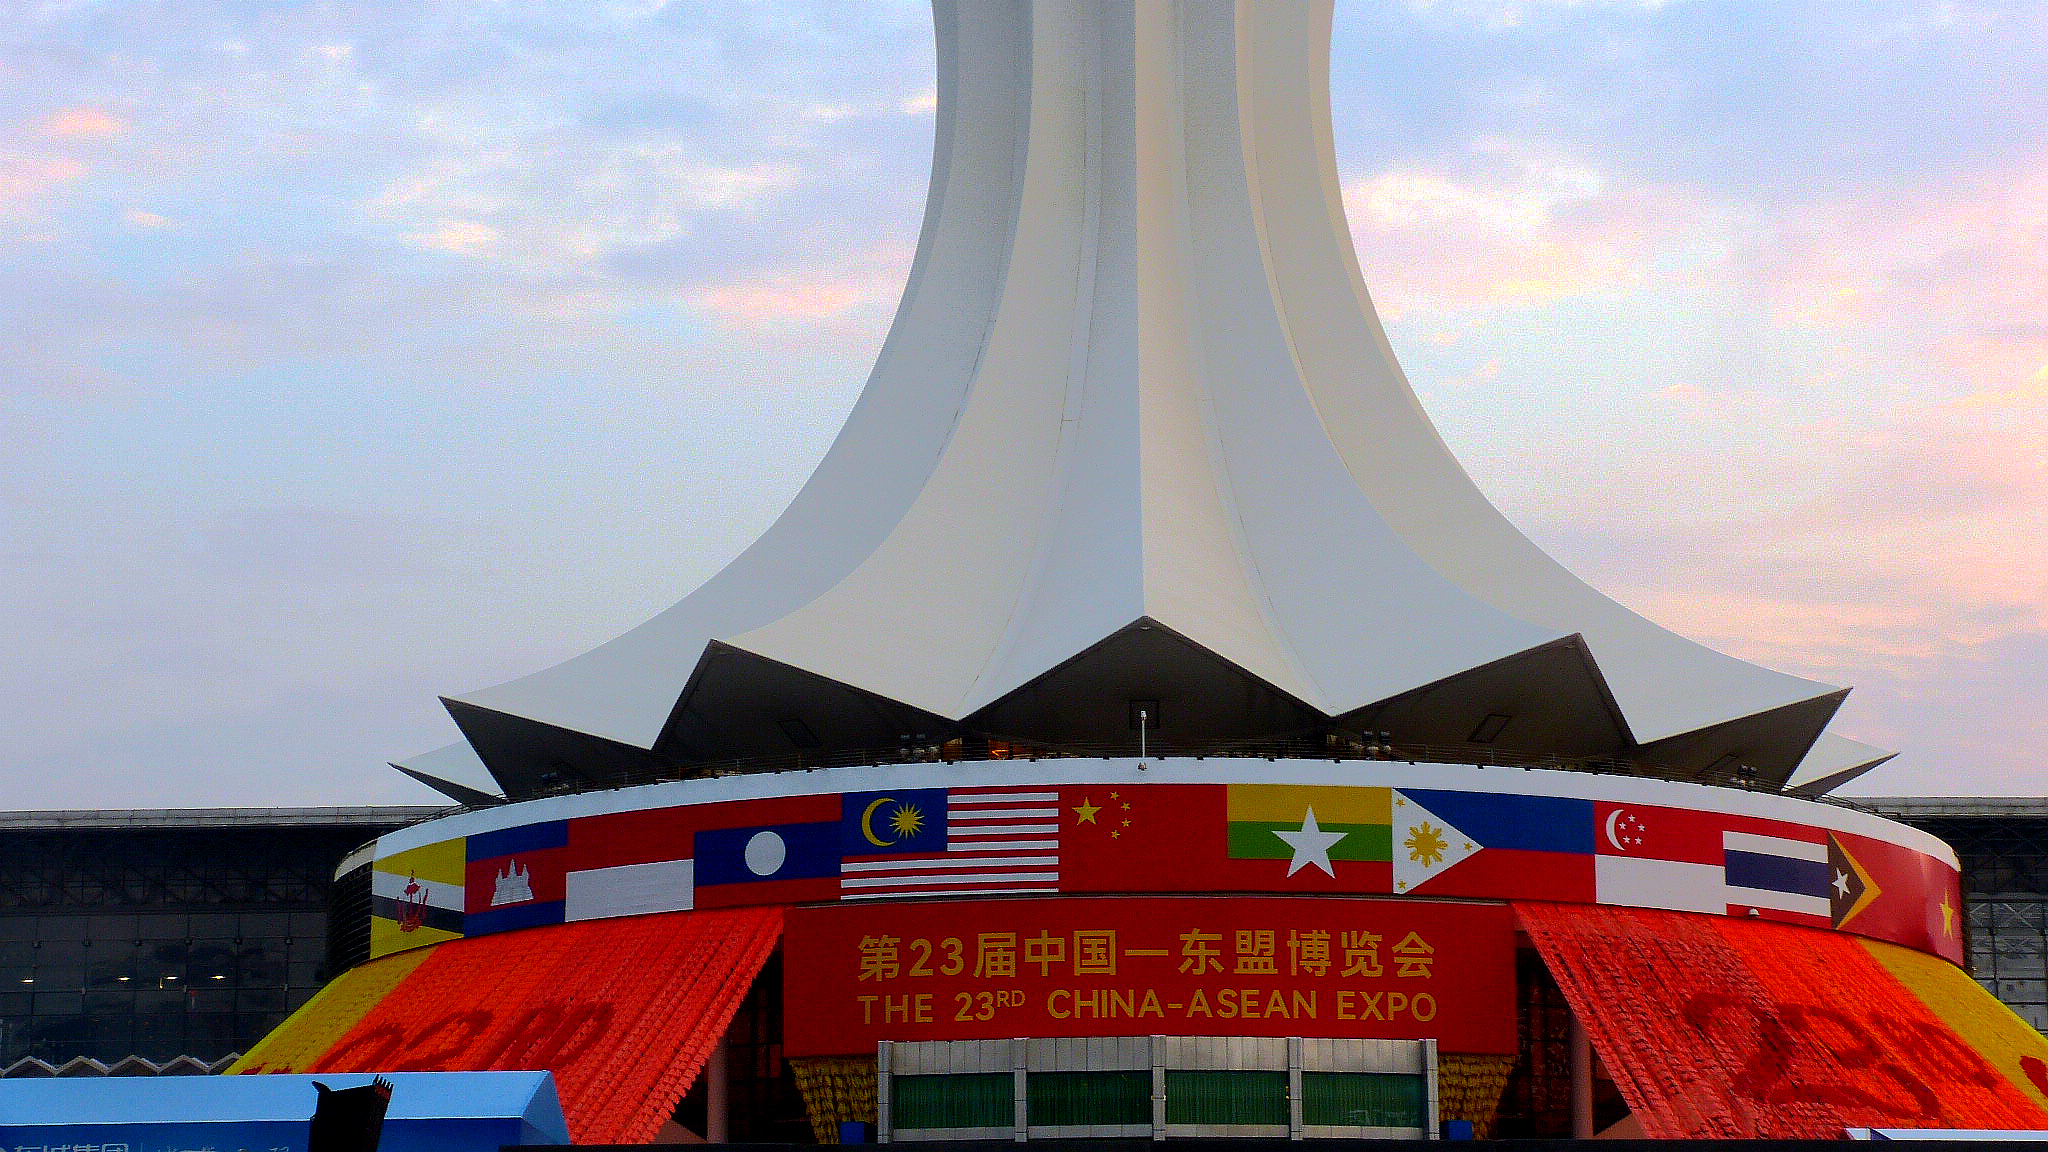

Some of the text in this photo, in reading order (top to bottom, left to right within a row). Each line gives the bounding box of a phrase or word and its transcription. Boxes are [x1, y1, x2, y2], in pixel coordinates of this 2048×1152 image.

[857, 988, 1437, 1024] THE 23RD CHINA-ASEAN EXPO
